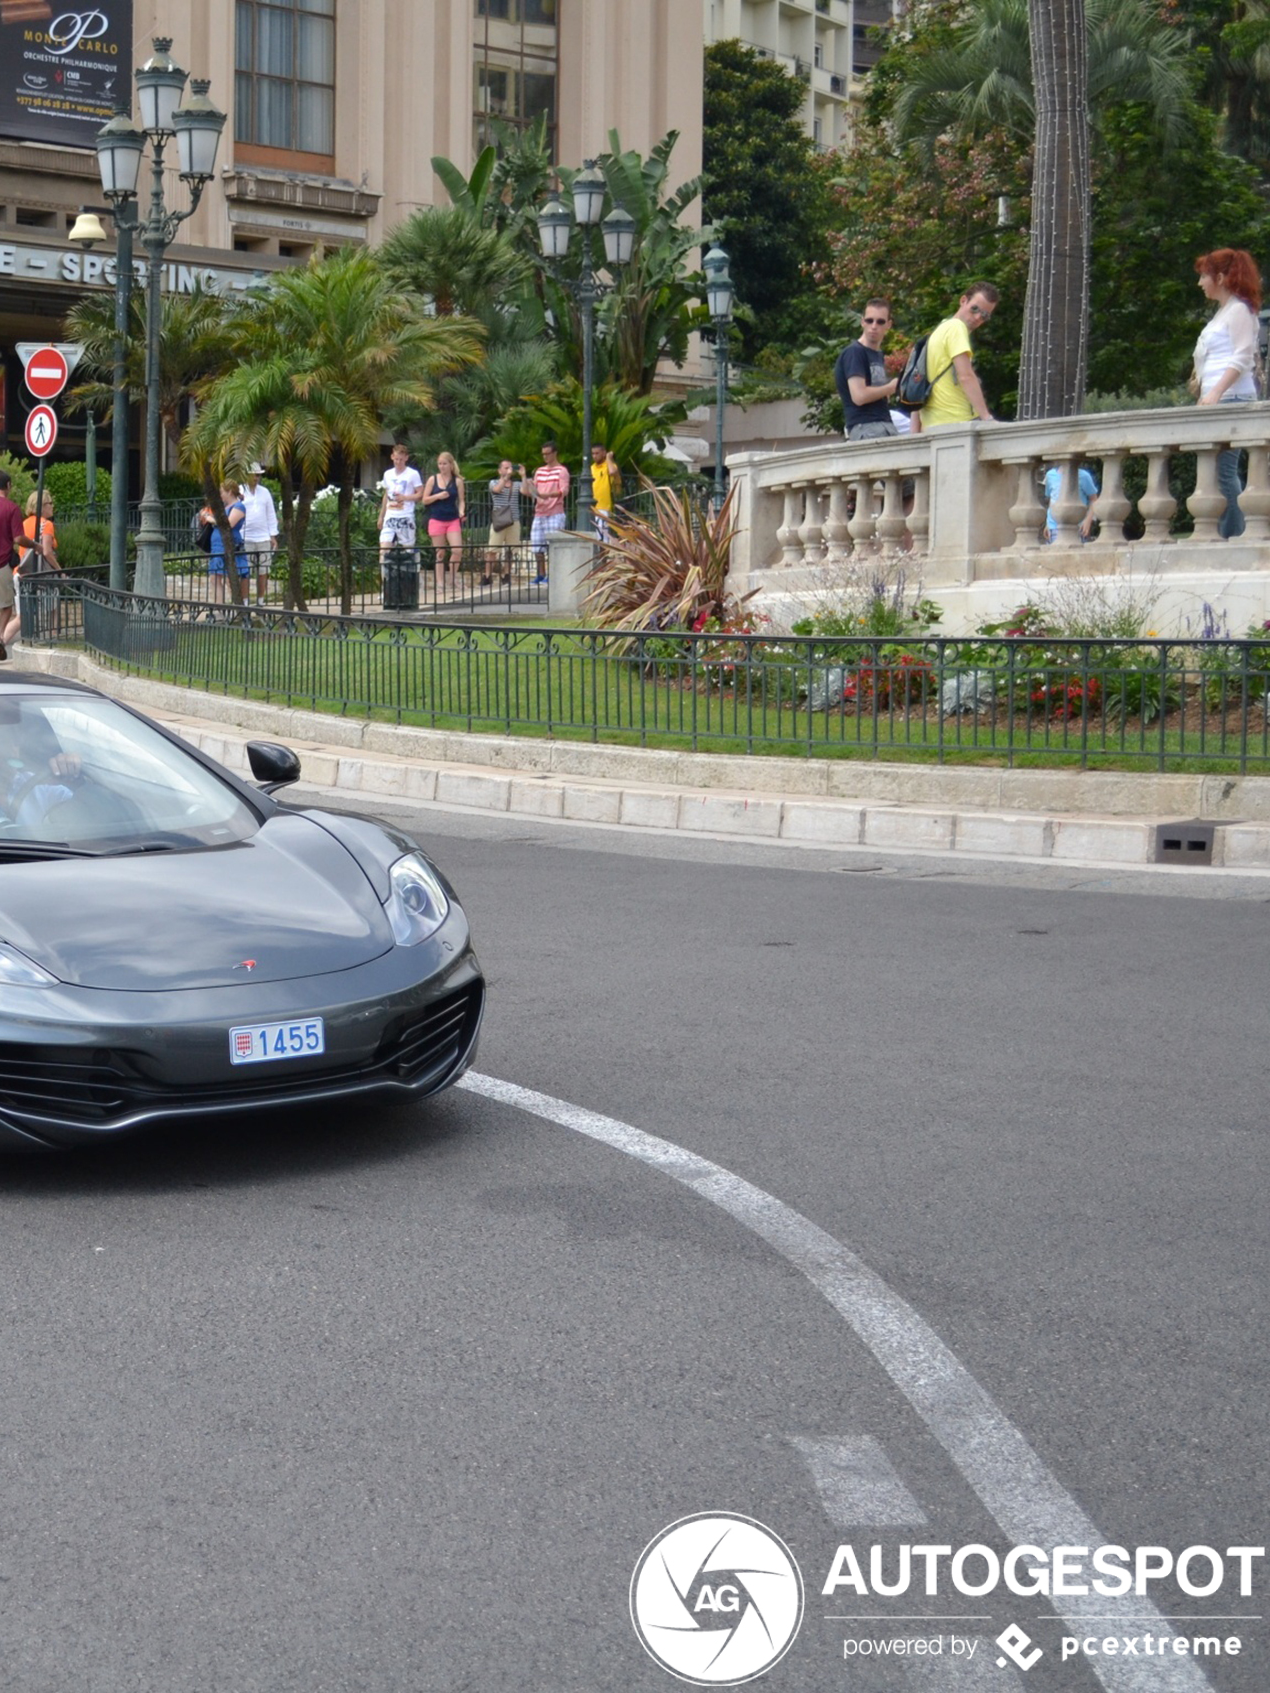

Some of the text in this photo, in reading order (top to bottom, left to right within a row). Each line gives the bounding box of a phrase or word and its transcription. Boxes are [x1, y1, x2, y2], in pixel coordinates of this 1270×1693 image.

[24, 30, 118, 55] MONTE CARLO
[23, 51, 118, 73] ORCHESTRE PHILHARMONIQUE
[66, 71, 81, 80] CMB
[283, 219, 304, 229] FORTIS
[259, 1024, 319, 1056] 1455
